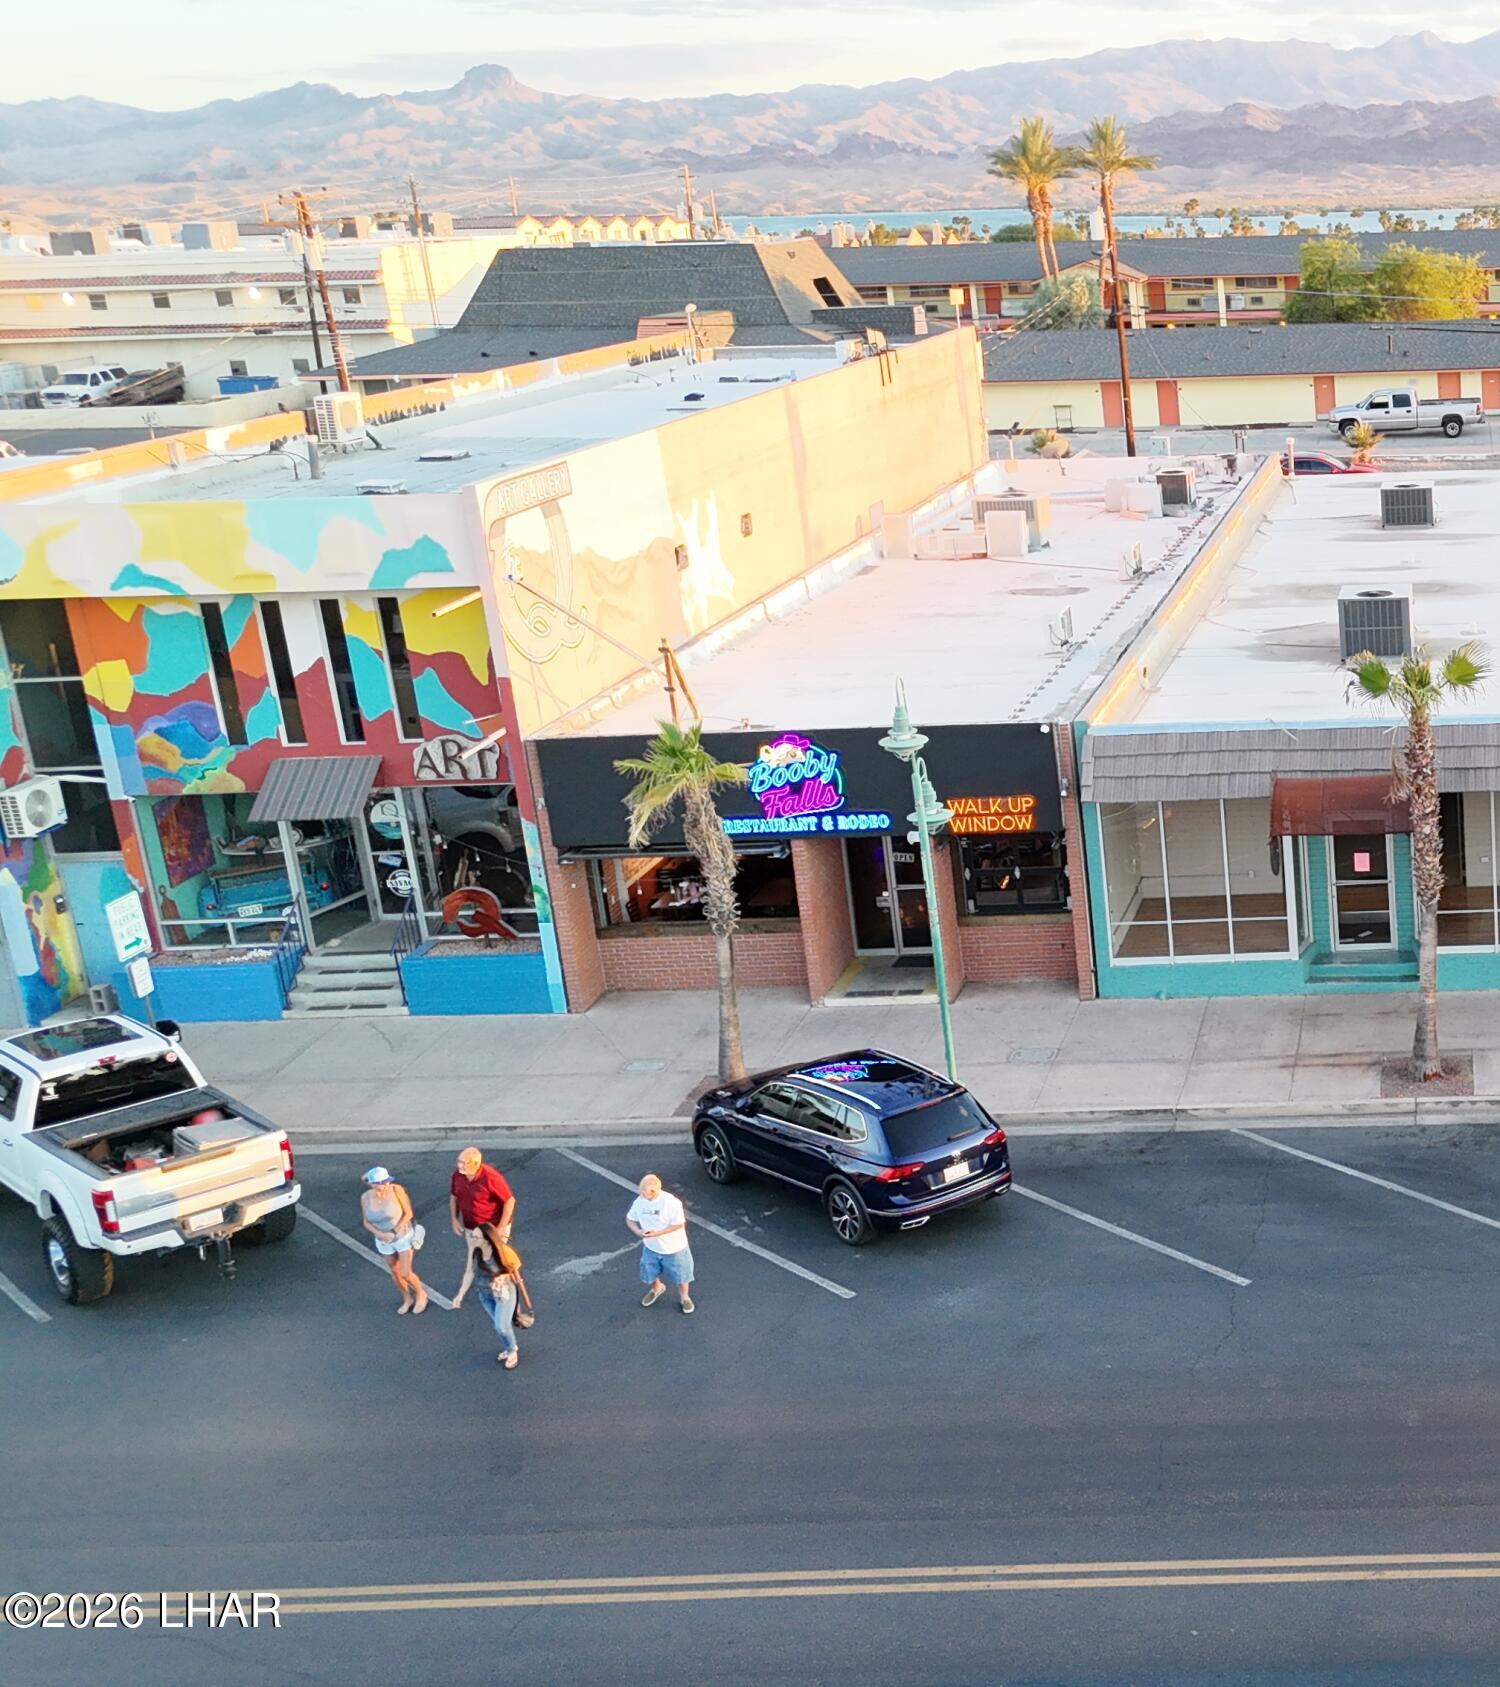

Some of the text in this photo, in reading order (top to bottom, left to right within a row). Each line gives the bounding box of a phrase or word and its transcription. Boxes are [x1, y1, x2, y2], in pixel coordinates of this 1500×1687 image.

[416, 738, 498, 781] ART
[751, 750, 837, 793] Booby
[761, 778, 839, 820] Falls
[946, 795, 1034, 815] WALK UP
[721, 813, 890, 834] RESTAURANT & RODEO
[949, 814, 1033, 833] WINDOW
